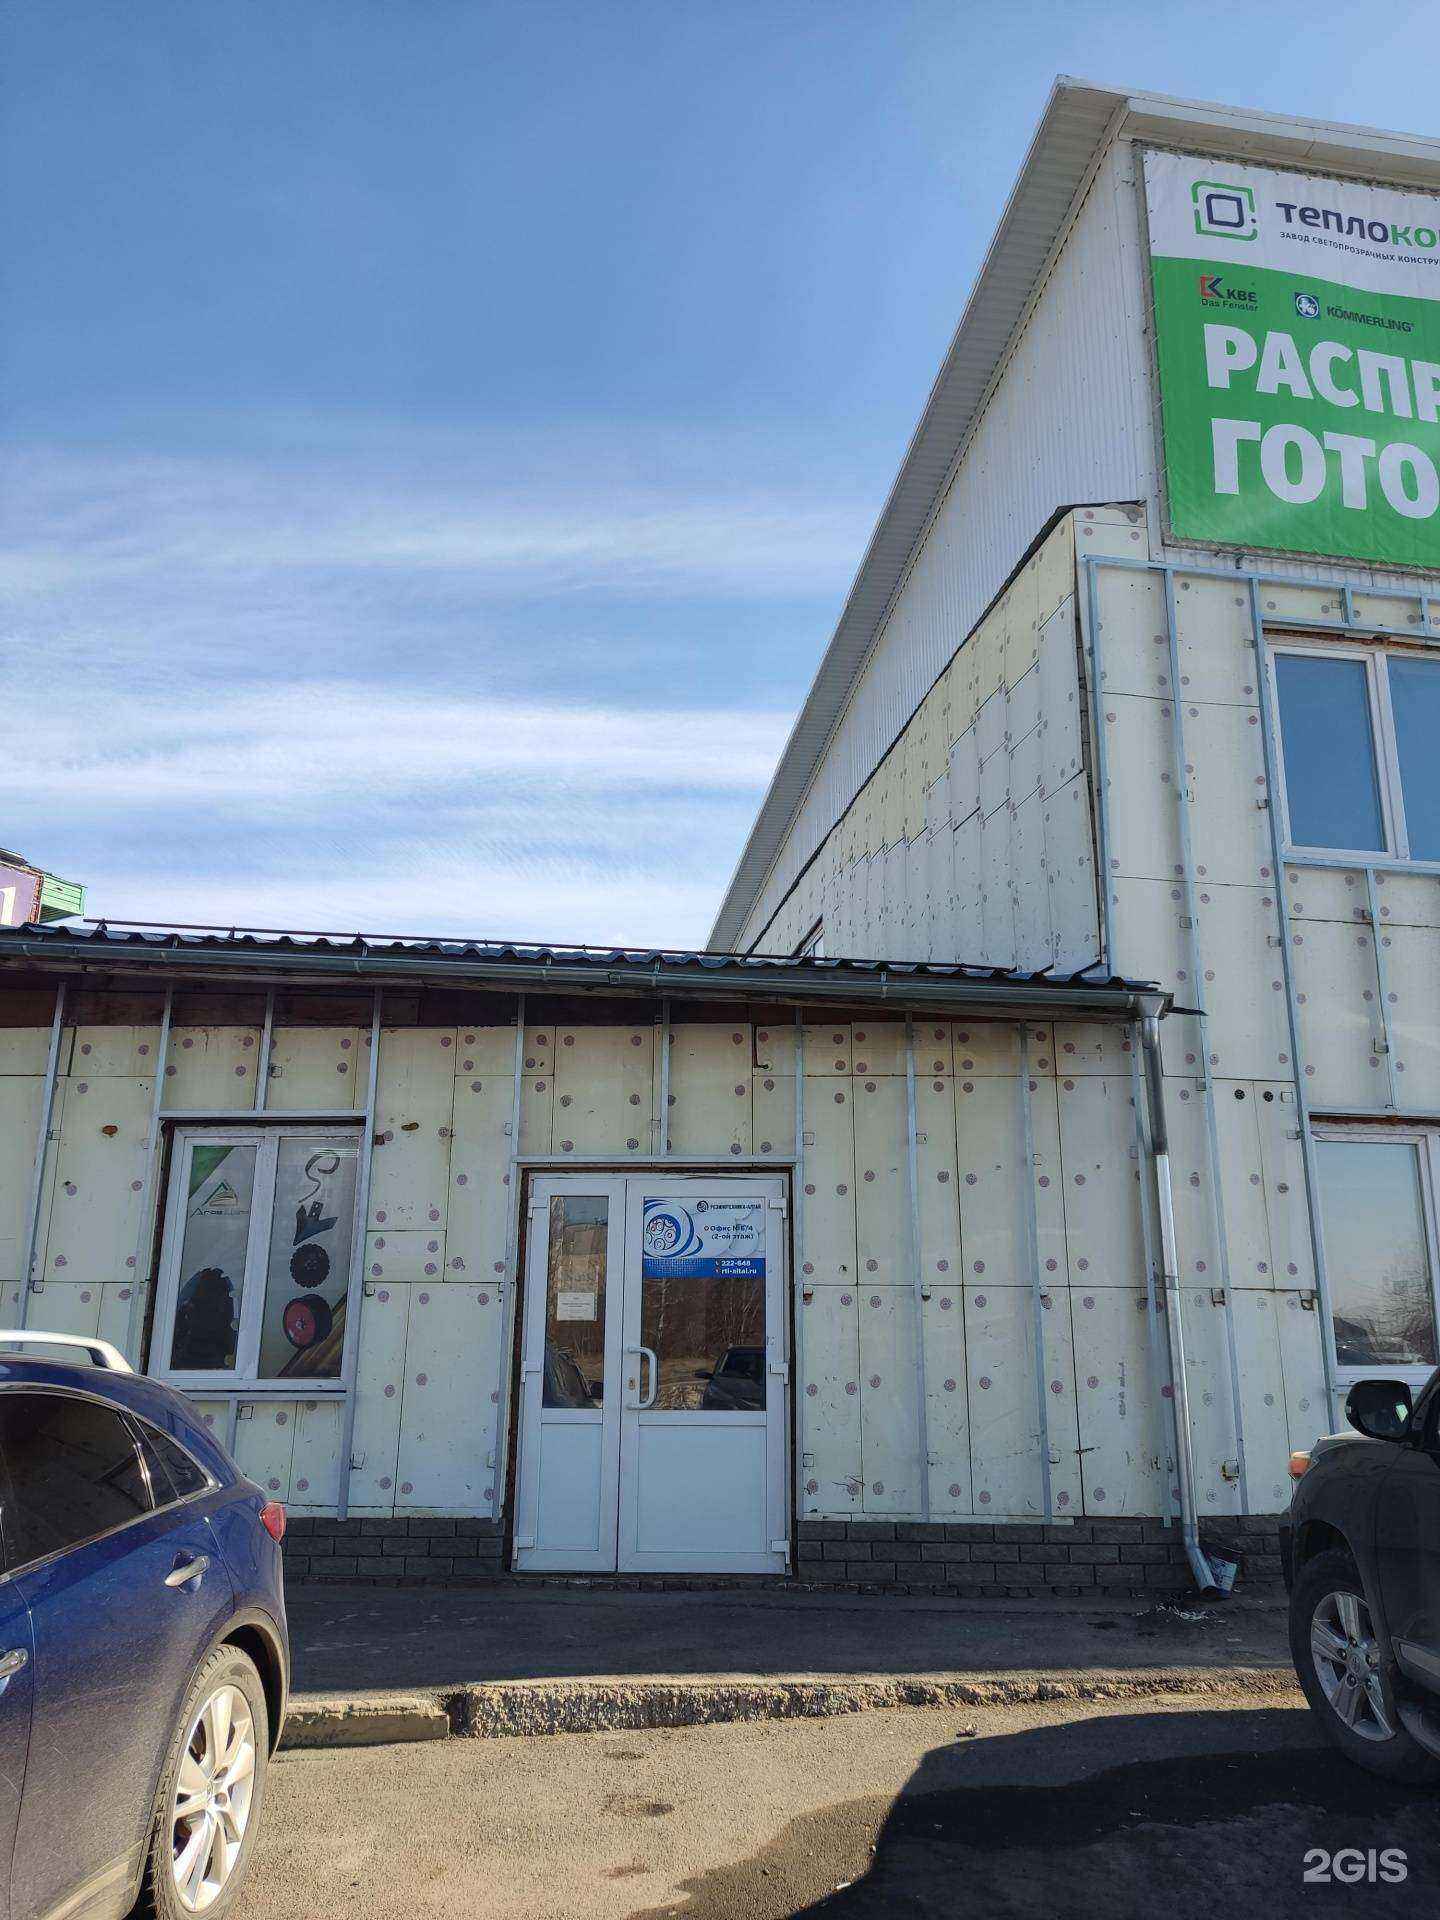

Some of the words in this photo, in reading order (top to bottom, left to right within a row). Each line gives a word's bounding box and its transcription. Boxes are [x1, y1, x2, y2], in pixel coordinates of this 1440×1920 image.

[1275, 202, 1440, 248] теплоко
[1279, 231, 1310, 244] ЗАВОД
[1312, 236, 1396, 262] СВЕТОПРОЗРАЧНЫХ
[1398, 255, 1440, 266] КОНСТРУ
[1201, 298, 1221, 308] Das
[1223, 300, 1259, 313] Fenster
[1226, 288, 1257, 303] KBE
[1203, 323, 1440, 423] РАСПР
[1211, 417, 1440, 519] ГОТО
